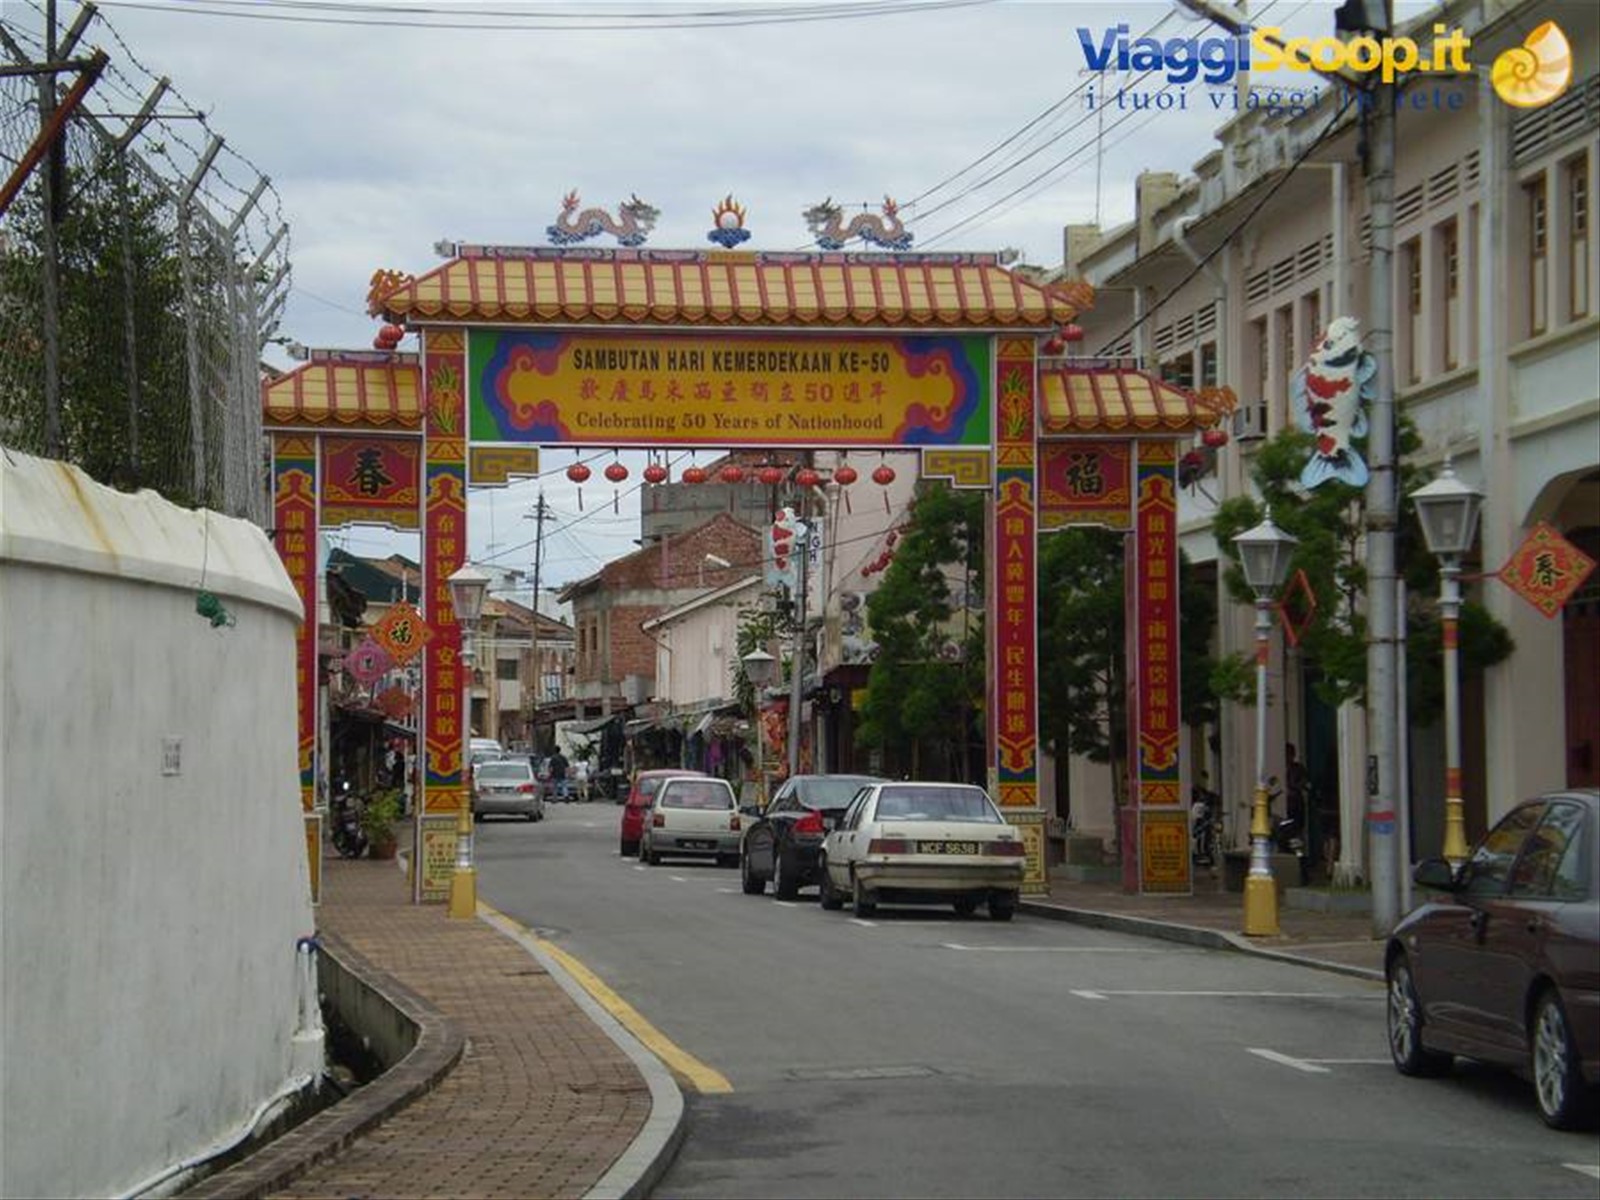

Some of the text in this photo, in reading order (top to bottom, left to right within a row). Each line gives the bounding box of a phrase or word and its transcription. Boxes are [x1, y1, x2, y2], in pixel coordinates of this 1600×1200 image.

[574, 350, 889, 373] SAMBUTAN HARI KEMERDEKAAN KE-50
[576, 411, 883, 431] Celebrating 50 Years of Nationhood
[348, 448, 394, 495] 春
[1066, 452, 1104, 495] 福
